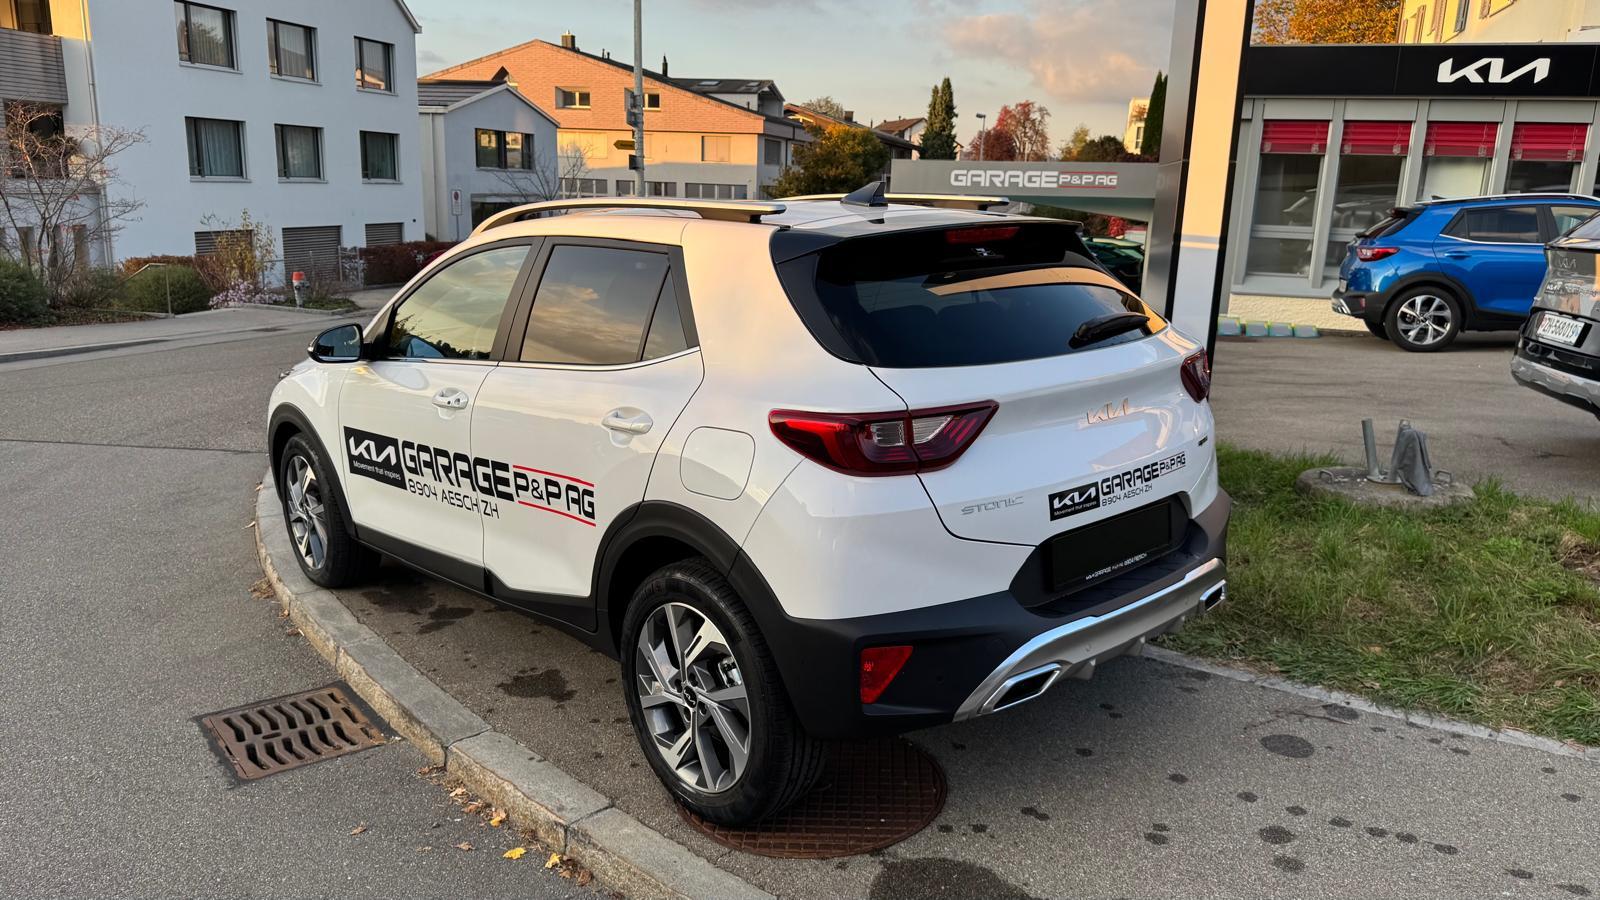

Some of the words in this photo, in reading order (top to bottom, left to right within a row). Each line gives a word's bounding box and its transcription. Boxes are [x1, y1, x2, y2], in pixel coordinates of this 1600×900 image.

[1437, 57, 1551, 84] KIA
[950, 169, 1059, 188] GARAGE
[1059, 175, 1095, 185] P&P
[1095, 175, 1118, 185] AG
[1086, 398, 1129, 424] KIA
[349, 436, 397, 466] KIA
[353, 460, 375, 471] Movement
[375, 466, 384, 475] that
[401, 440, 515, 502] GARAGE
[513, 471, 562, 506] P&P
[565, 483, 596, 520] AG
[1101, 461, 1160, 497] GARAGE
[1160, 458, 1176, 474] P&P
[1176, 453, 1186, 466] AG
[408, 478, 438, 501] 8904
[441, 489, 480, 514] AESCH
[481, 499, 500, 519] ZH
[961, 496, 1025, 515] STONIC
[1053, 486, 1097, 509] KIA
[1101, 495, 1122, 507] 8904
[1122, 487, 1144, 500] AESCH
[1144, 483, 1153, 493] ZH
